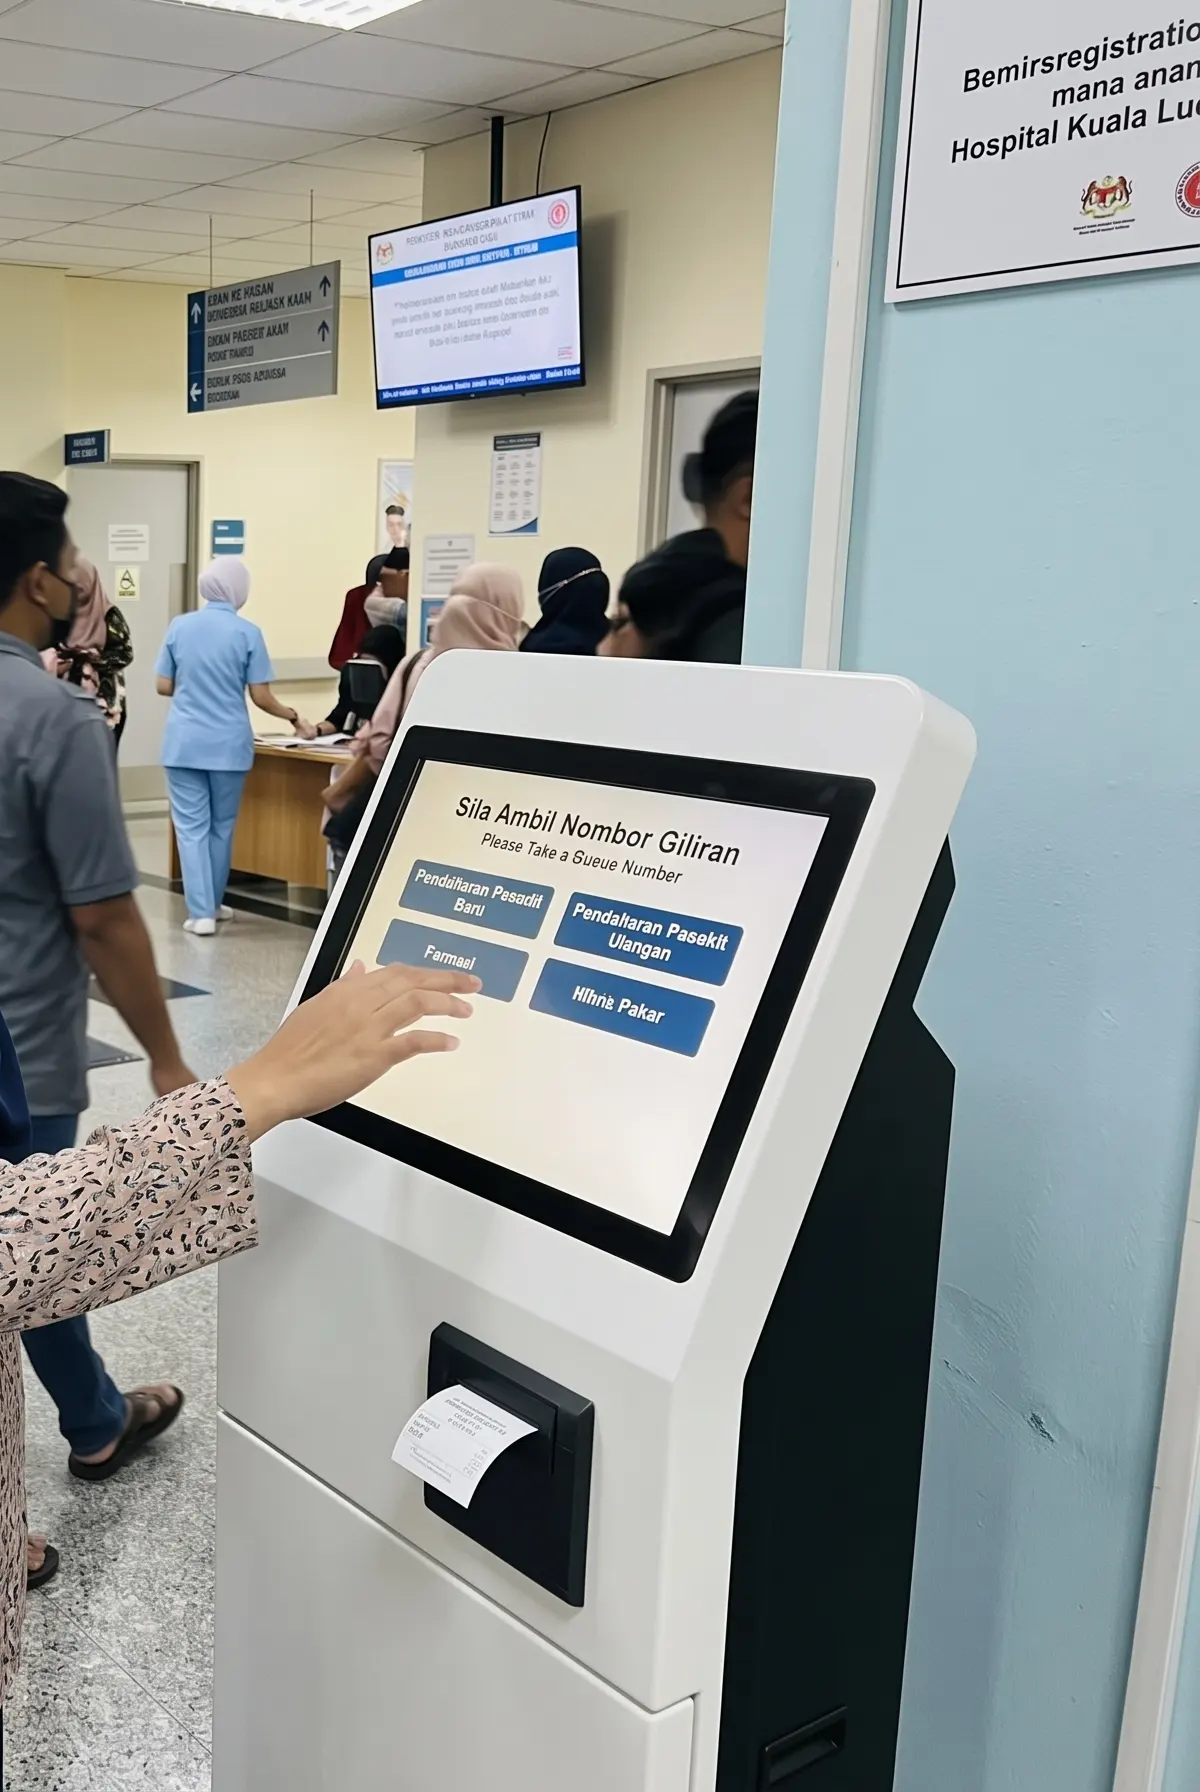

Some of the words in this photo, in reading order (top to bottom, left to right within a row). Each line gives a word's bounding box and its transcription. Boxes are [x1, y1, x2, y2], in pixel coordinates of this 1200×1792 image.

[1052, 76, 1124, 108] mana
[951, 119, 1059, 163] Hospital
[1067, 105, 1147, 141] Kuala
[1157, 98, 1200, 124] Lu
[455, 796, 492, 821] Sila
[494, 803, 558, 833] Ambil
[560, 813, 654, 849] Nombor
[659, 830, 740, 866] Giliran
[481, 832, 523, 853] Please
[527, 841, 557, 860] Take
[559, 851, 569, 862] a
[621, 859, 683, 884] Number
[453, 897, 486, 917] Baru
[608, 932, 672, 962] Ulangan
[617, 998, 666, 1024] Pakar
